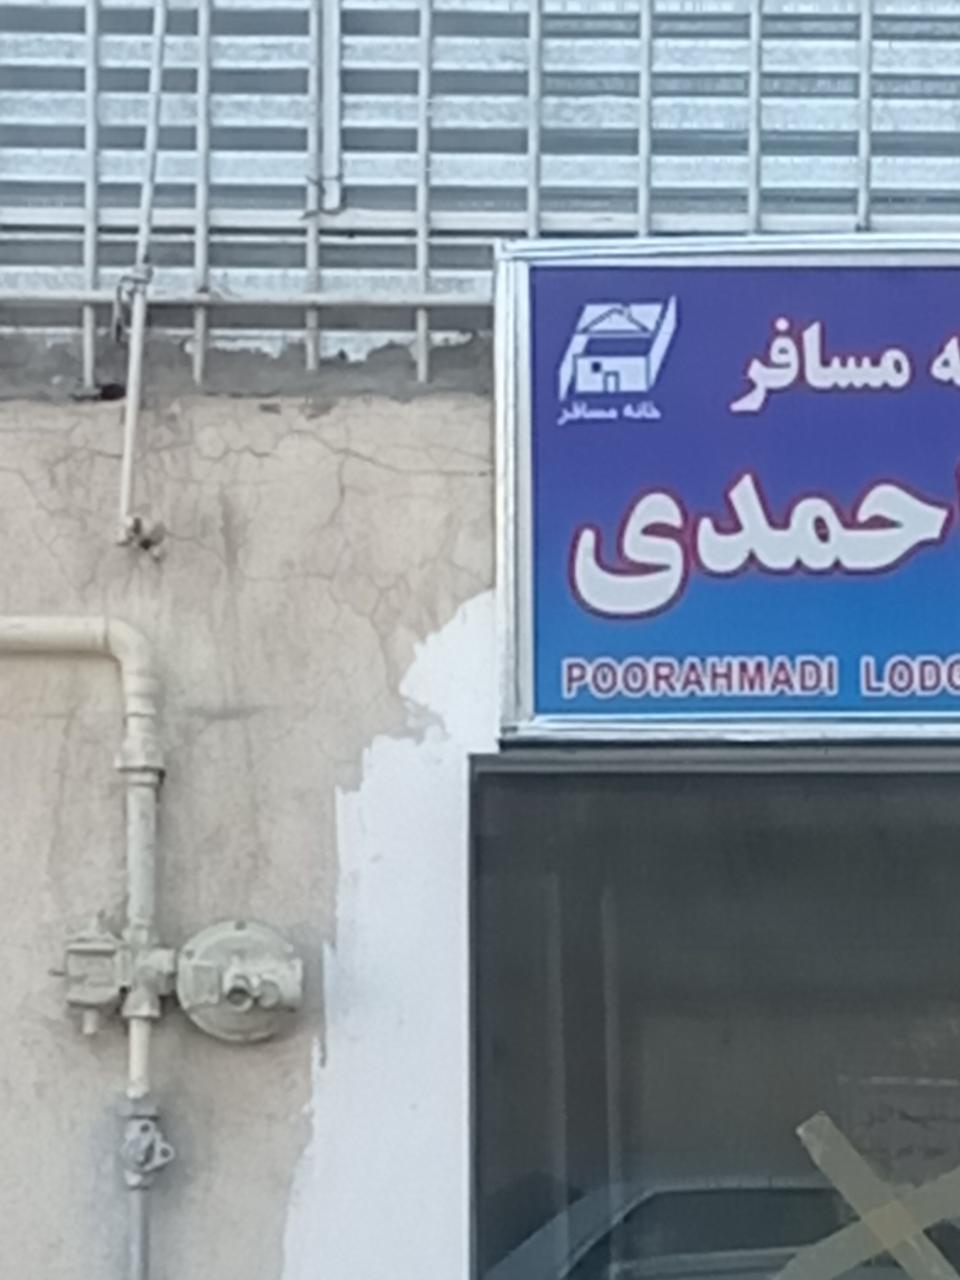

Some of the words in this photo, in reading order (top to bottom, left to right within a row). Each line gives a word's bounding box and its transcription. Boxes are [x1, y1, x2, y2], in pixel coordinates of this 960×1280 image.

[729, 315, 912, 413] مسافر
[623, 402, 662, 419] خانه
[562, 656, 837, 698] POORAHMADI
